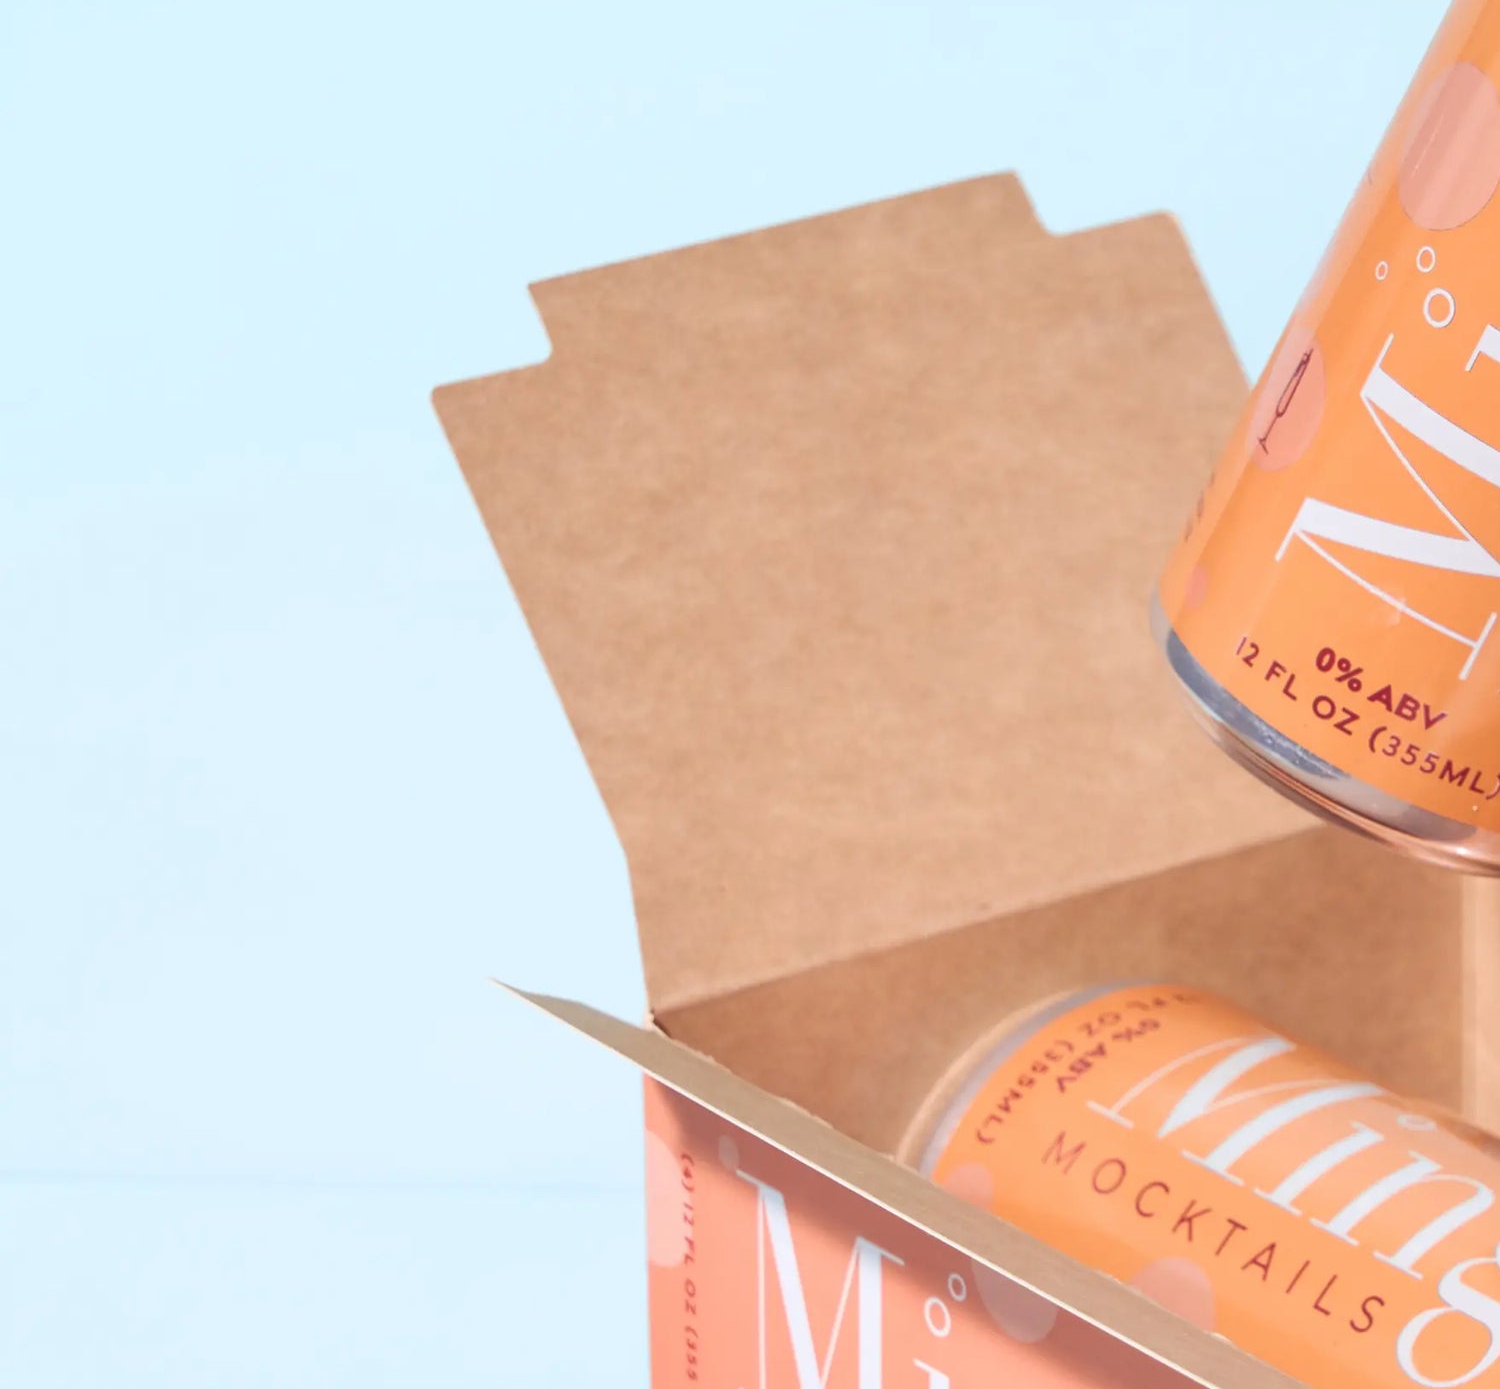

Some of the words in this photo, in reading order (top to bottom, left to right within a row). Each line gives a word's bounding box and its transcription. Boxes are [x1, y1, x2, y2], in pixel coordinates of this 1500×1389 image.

[1236, 636, 1260, 667] 12
[1264, 660, 1298, 702] FL
[1312, 695, 1353, 737] OZ
[1315, 647, 1362, 693] 0%
[1369, 684, 1447, 732] ABV
[1041, 1130, 1386, 1334] MOCKTAILS
[685, 1279, 698, 1315] OZ
